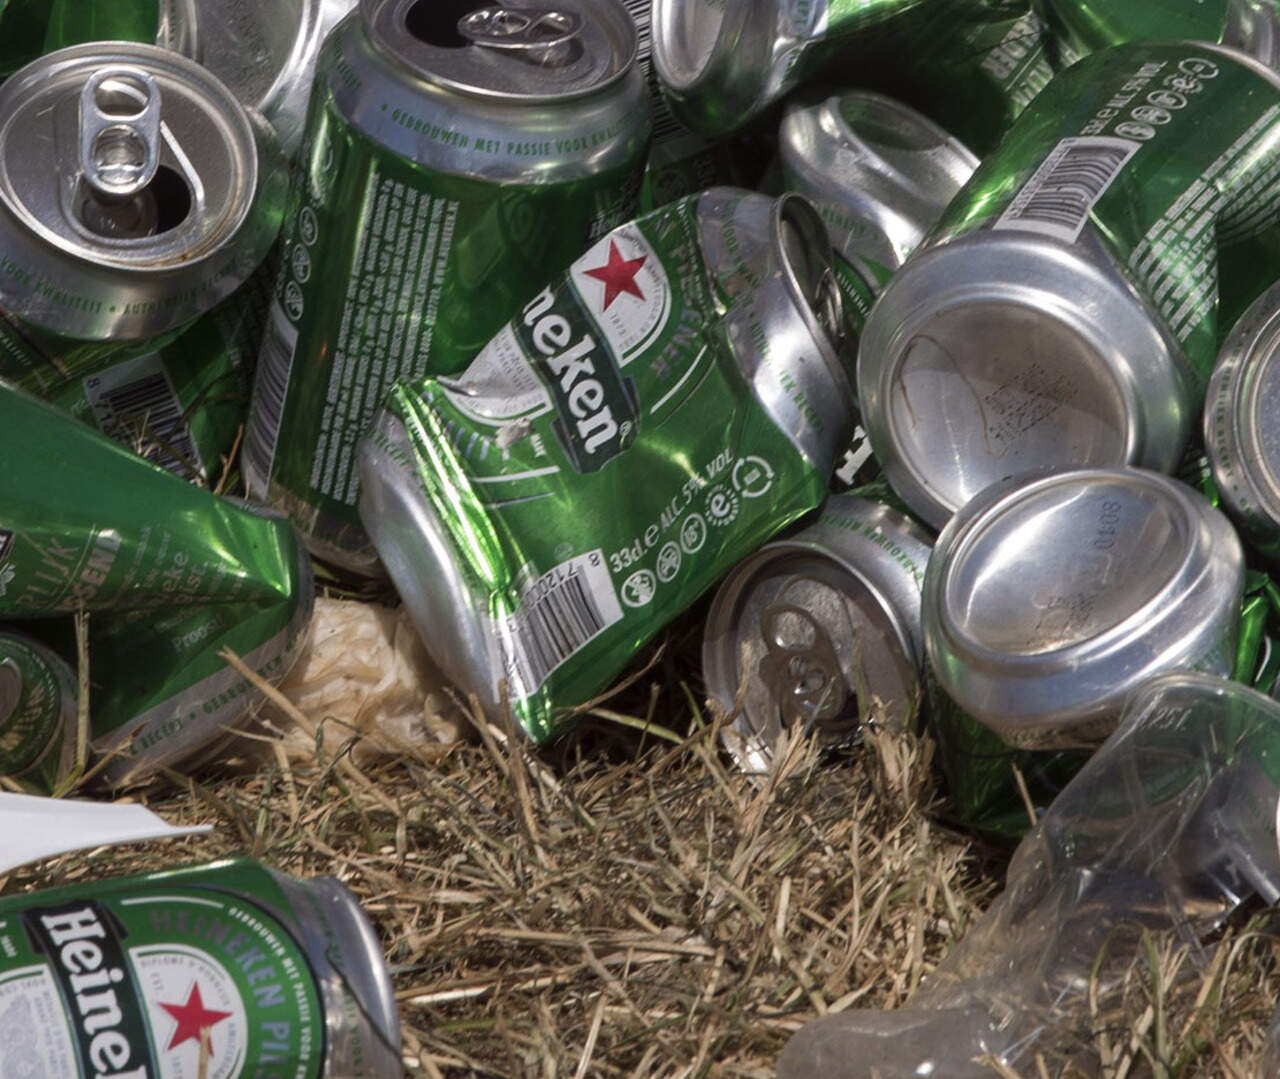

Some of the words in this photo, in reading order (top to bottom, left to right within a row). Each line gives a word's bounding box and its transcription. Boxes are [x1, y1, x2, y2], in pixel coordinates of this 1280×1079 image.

[391, 107, 469, 149] GEBROUWEN
[473, 137, 502, 156] MET
[506, 140, 552, 157] PASSIE
[554, 138, 589, 156] VOOR
[225, 904, 286, 964] GEBROUWEN
[150, 911, 286, 1010] HEINEKEN
[279, 962, 297, 982] MET
[291, 981, 311, 1022] PASSIE
[298, 1024, 313, 1056] VOOR
